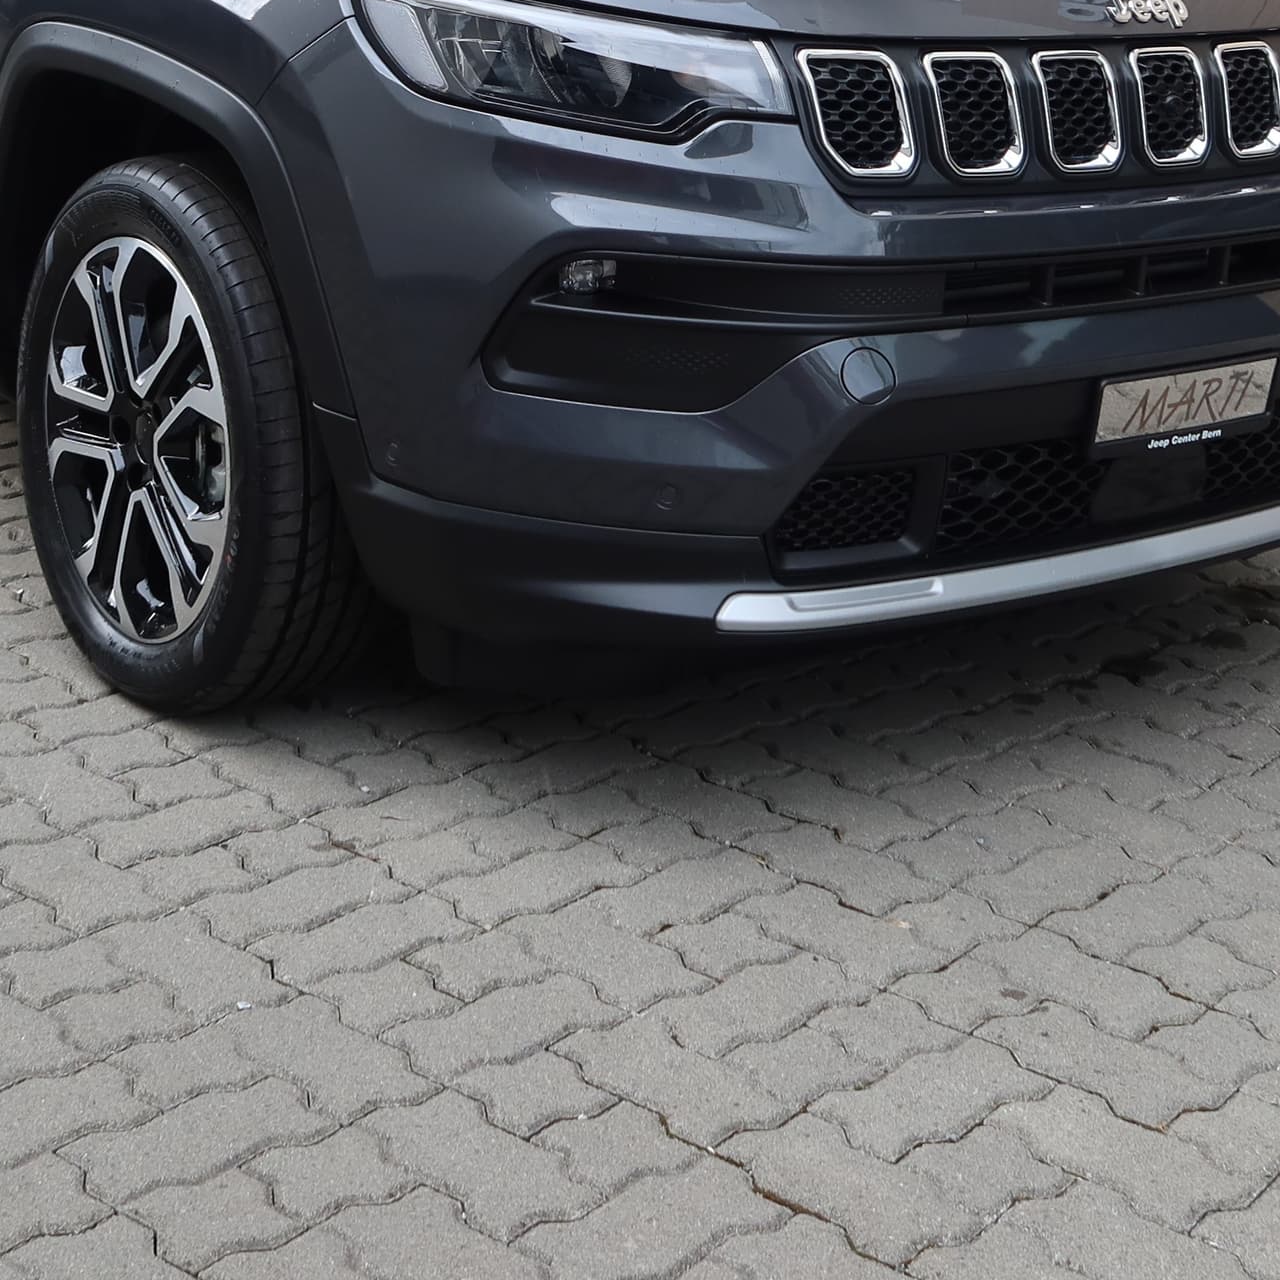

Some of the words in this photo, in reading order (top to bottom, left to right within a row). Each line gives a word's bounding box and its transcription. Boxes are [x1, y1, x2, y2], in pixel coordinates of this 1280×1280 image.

[1122, 370, 1255, 433] MARTI
[1147, 439, 1170, 449] Jeep
[1171, 433, 1200, 445] Center
[1201, 429, 1222, 439] Bern
